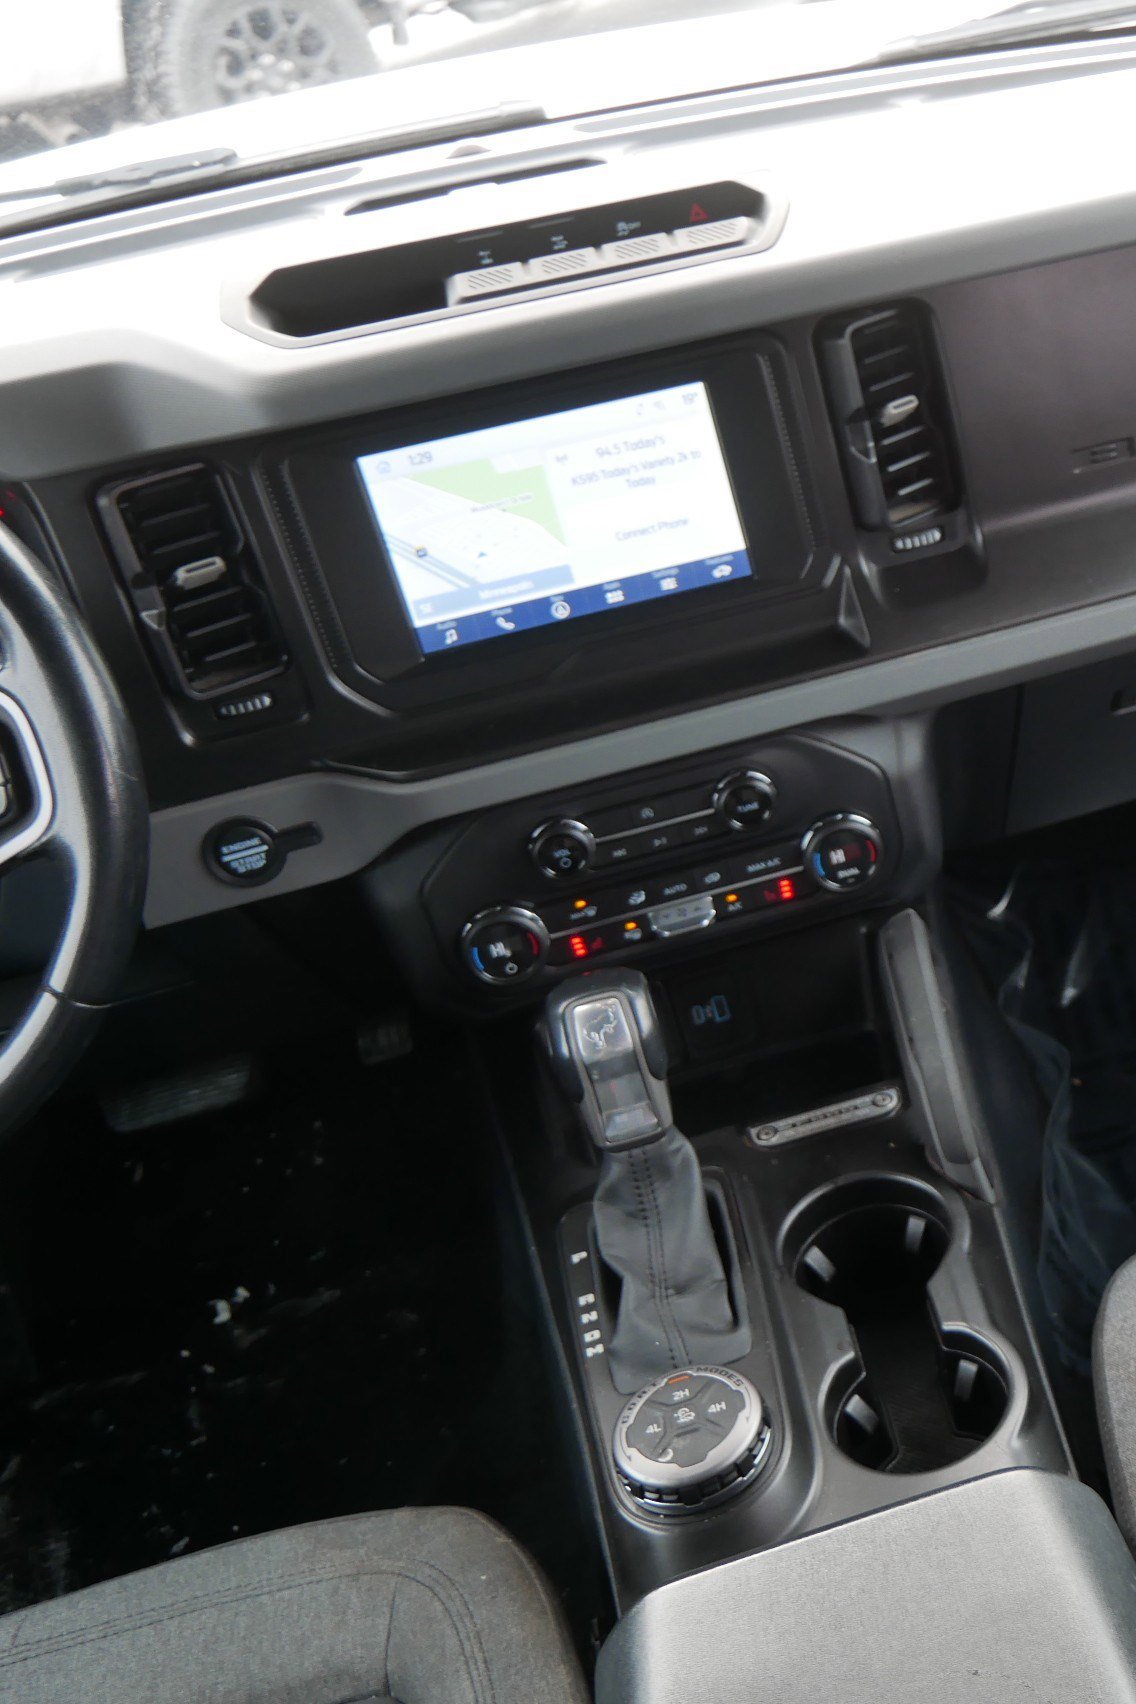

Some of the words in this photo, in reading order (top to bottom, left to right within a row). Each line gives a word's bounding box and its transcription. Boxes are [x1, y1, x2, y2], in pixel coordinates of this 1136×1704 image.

[595, 443, 622, 458] 94.5
[622, 435, 666, 452] Today's
[407, 451, 434, 466] 1:29
[601, 462, 640, 479] Today's
[640, 455, 676, 472] Variety
[625, 476, 656, 489] Today
[615, 525, 657, 542] Connect
[657, 517, 690, 532] Phone
[662, 882, 688, 895] AUTO
[695, 1365, 745, 1388] MODES
[671, 1388, 690, 1401] 2H
[707, 1401, 727, 1414] 4H
[645, 1422, 662, 1434] 4L
